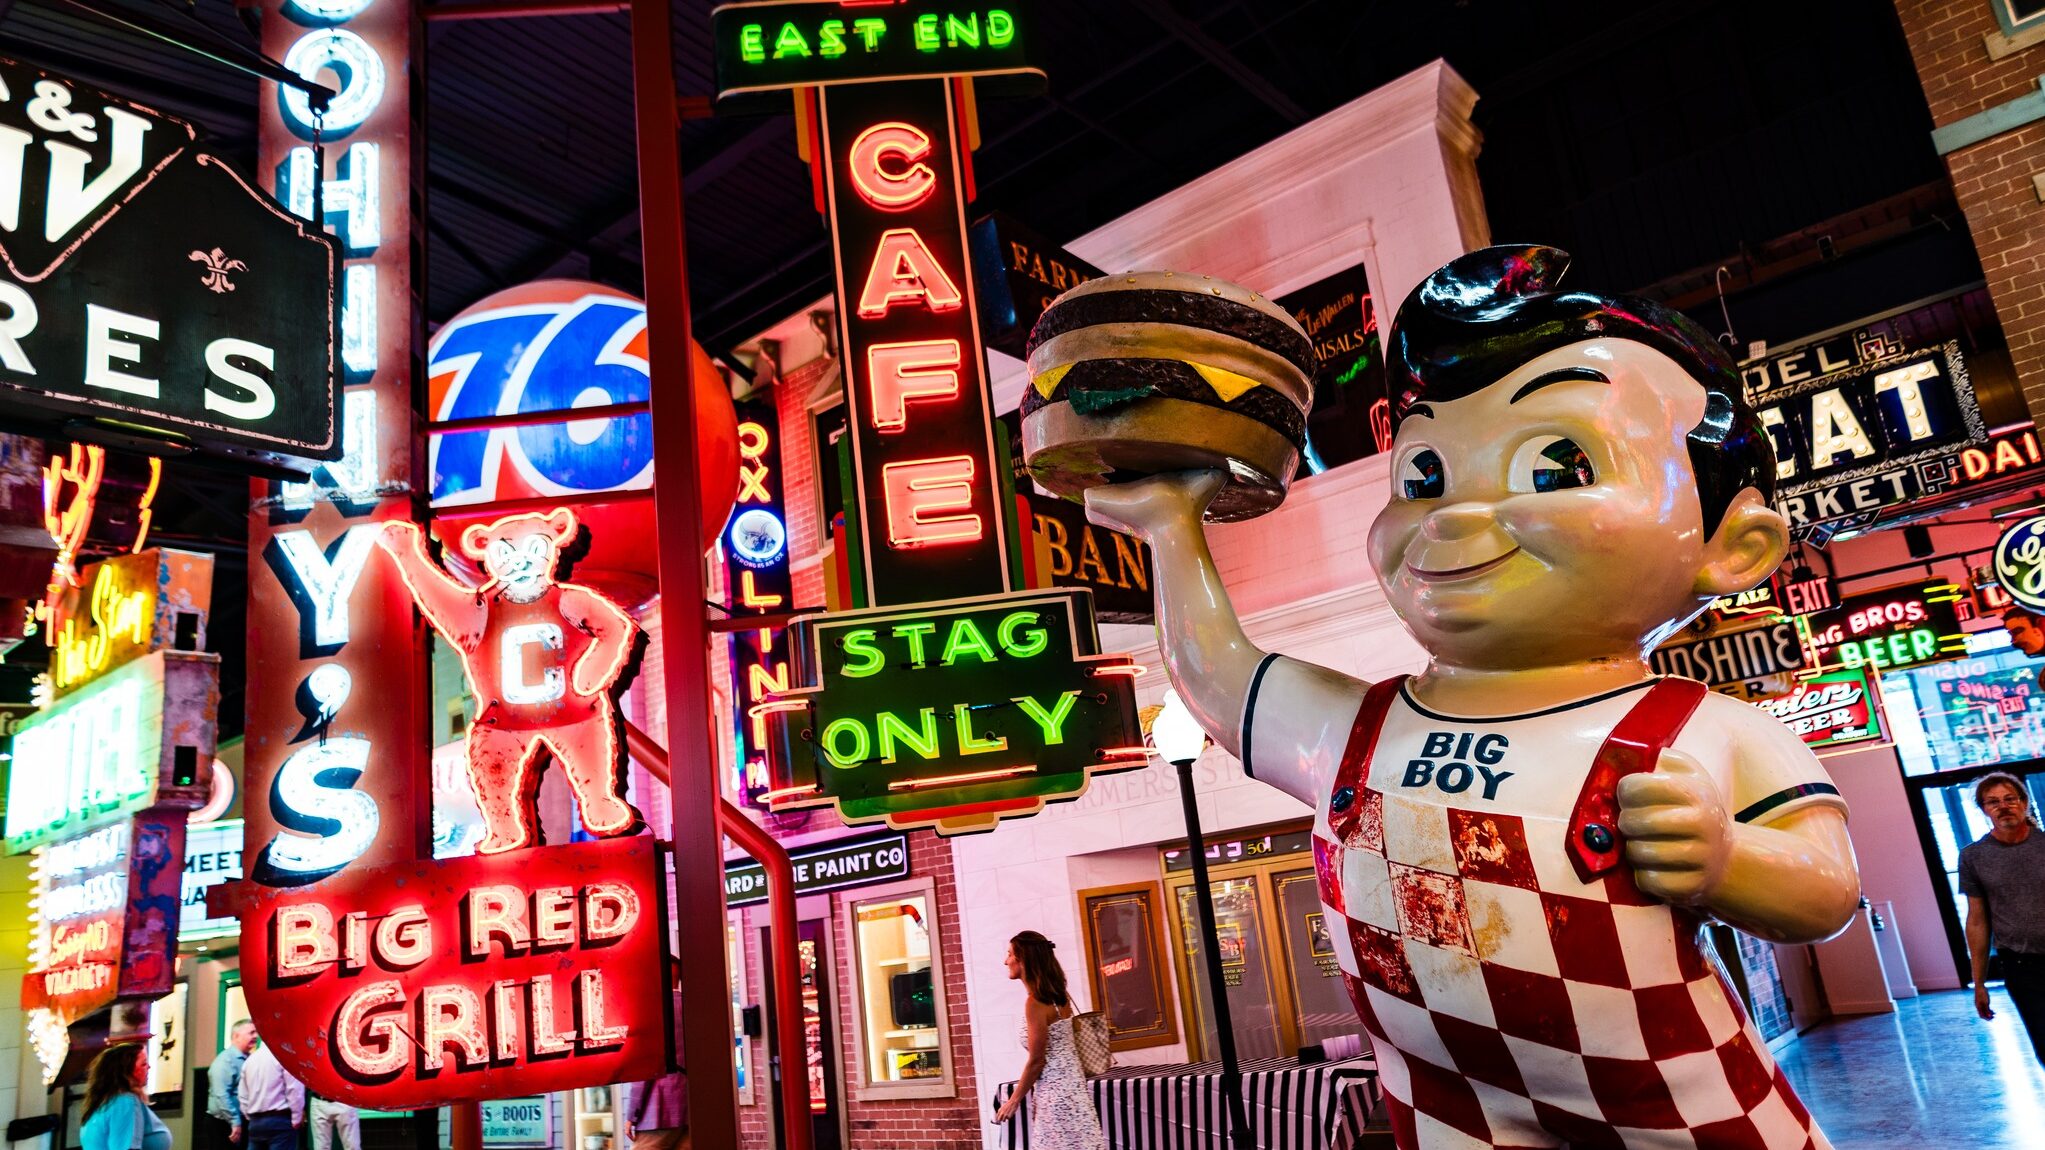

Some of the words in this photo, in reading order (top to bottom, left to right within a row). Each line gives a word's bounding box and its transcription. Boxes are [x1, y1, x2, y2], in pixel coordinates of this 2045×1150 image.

[741, 18, 887, 61] EAST
[914, 10, 1014, 51] END
[26, 80, 98, 142] &
[850, 121, 982, 550] CAFE
[429, 294, 653, 507] 76
[774, 551, 784, 562] OX
[1736, 587, 1771, 607] ALE
[1785, 577, 1831, 616] EXIT
[840, 611, 1049, 678] STAG
[1803, 625, 1845, 650] NG
[1838, 629, 1936, 669] BEER
[501, 622, 565, 704] C
[821, 689, 1082, 769] ONLY
[1420, 732, 1509, 765] BIG
[1401, 759, 1515, 801] BOY
[815, 852, 872, 880] PAINT
[875, 847, 904, 869] CO
[277, 902, 433, 978] BIG
[468, 882, 640, 956] RED
[336, 968, 629, 1074] GRILL
[503, 1104, 541, 1122] BOOTS
